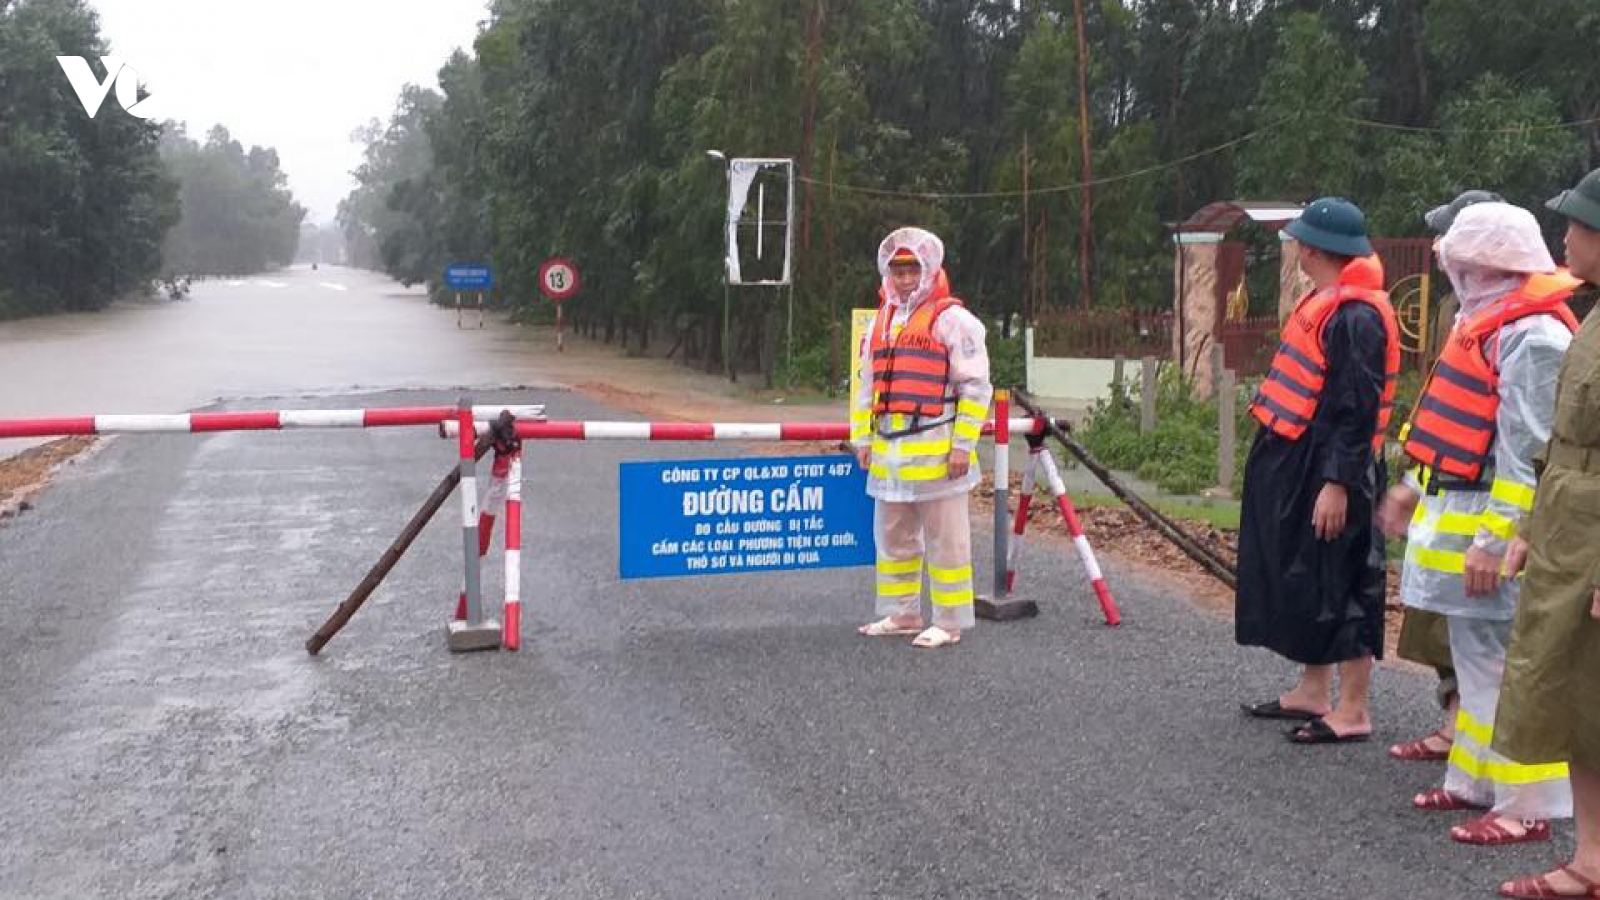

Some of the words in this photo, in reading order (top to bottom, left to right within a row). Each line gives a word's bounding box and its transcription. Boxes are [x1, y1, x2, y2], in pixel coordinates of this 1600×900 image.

[662, 465, 700, 483] CÔNG
[704, 467, 718, 481] TY
[723, 466, 740, 481] CP
[683, 484, 763, 516] ĐƯỜNG
[771, 480, 823, 512] CẤM
